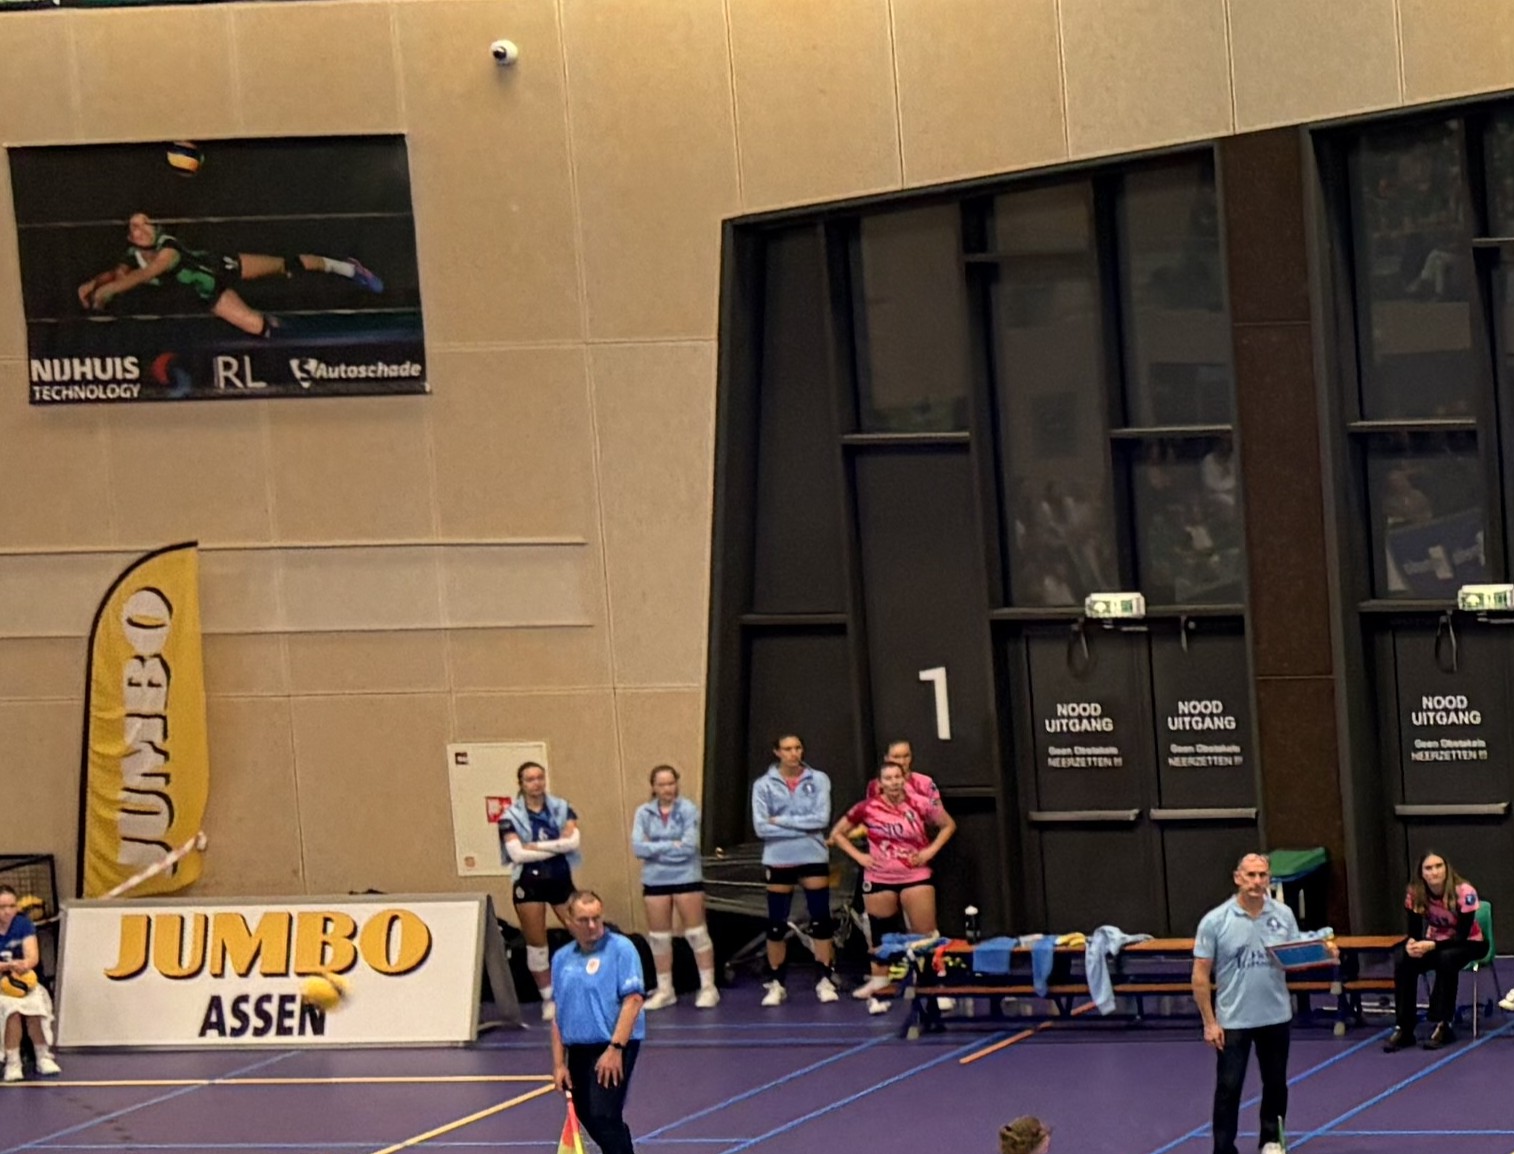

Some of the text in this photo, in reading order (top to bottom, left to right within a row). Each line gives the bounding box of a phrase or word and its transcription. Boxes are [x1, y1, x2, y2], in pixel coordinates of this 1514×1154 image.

[315, 360, 422, 381] Autoschade
[32, 383, 141, 402] TECHNOLOGY
[918, 666, 951, 740] 1
[1056, 703, 1102, 717] NOOD
[1177, 700, 1223, 714] NOOD
[1422, 695, 1468, 709] NOOD
[1045, 718, 1114, 733] UITGANG
[1167, 716, 1236, 730] UITGANG
[1411, 710, 1482, 725] UITGANG
[117, 585, 176, 878] JUMBO
[103, 908, 433, 980] JUMBO
[198, 993, 325, 1038] ASSEN
